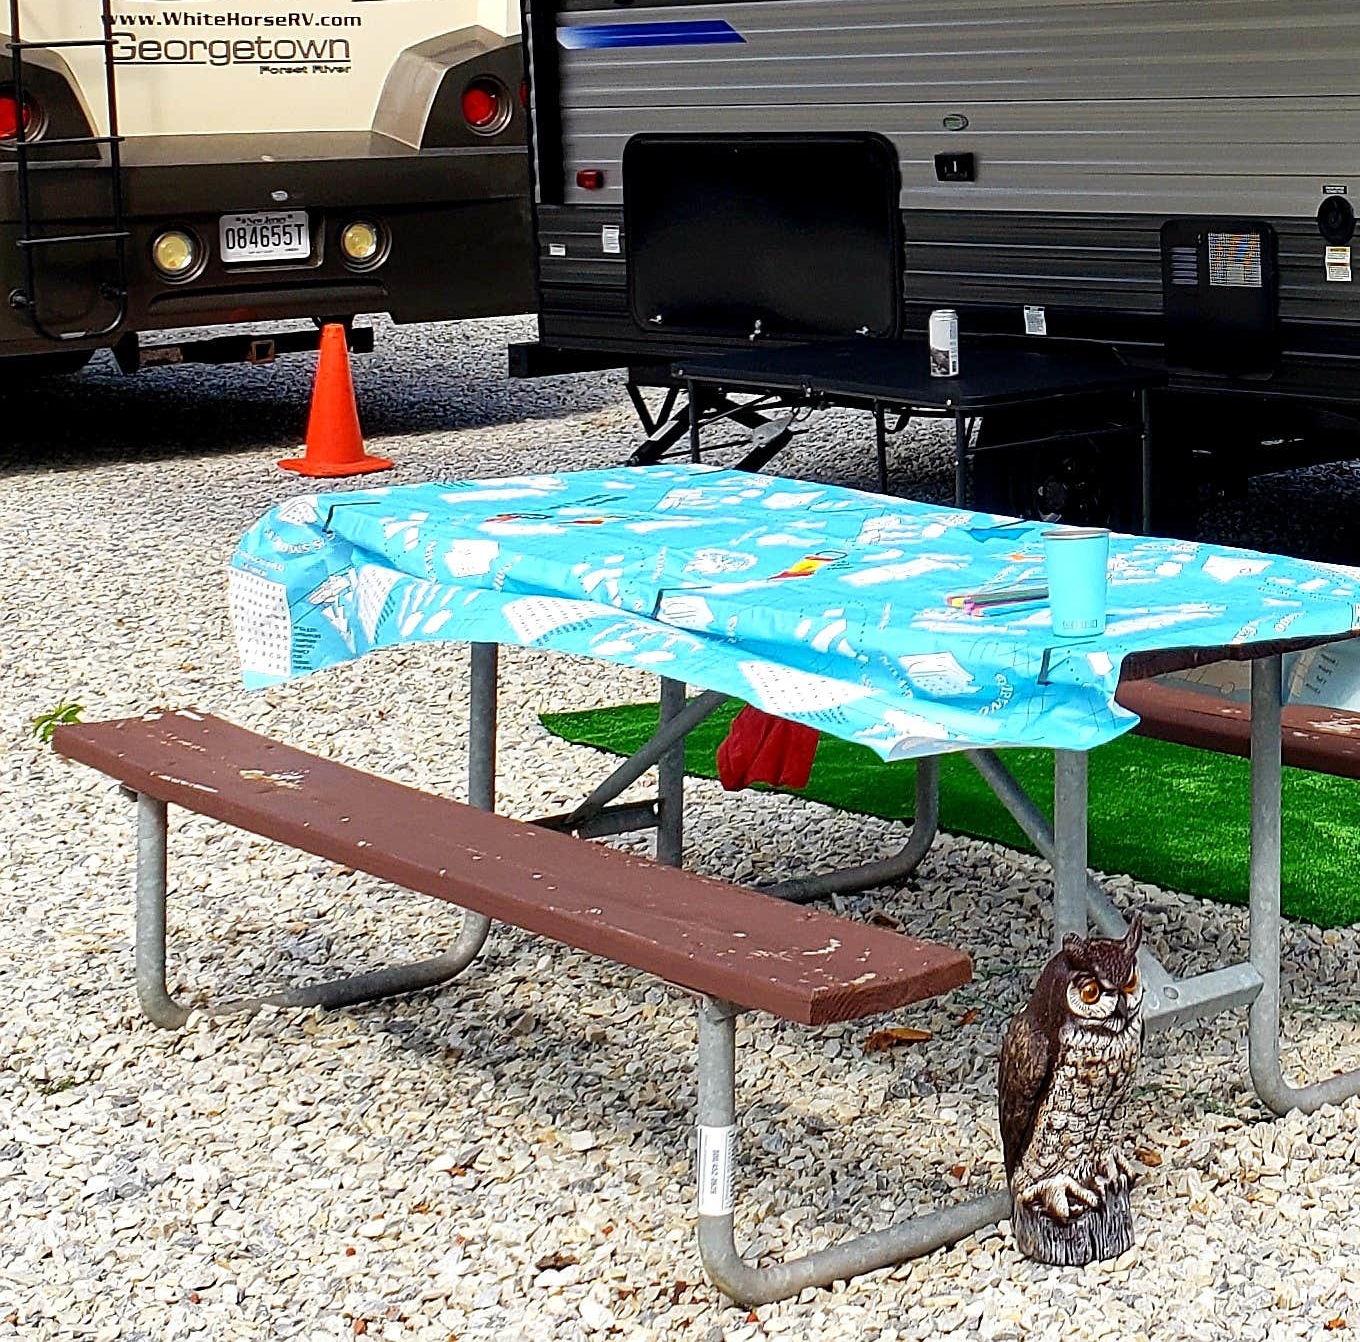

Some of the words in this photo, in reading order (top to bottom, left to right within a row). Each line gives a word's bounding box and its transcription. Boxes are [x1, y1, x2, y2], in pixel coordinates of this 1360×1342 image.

[110, 31, 350, 66] Georgetown
[260, 65, 308, 75] Forest
[312, 65, 352, 74] River
[225, 223, 305, 250] 084655T
